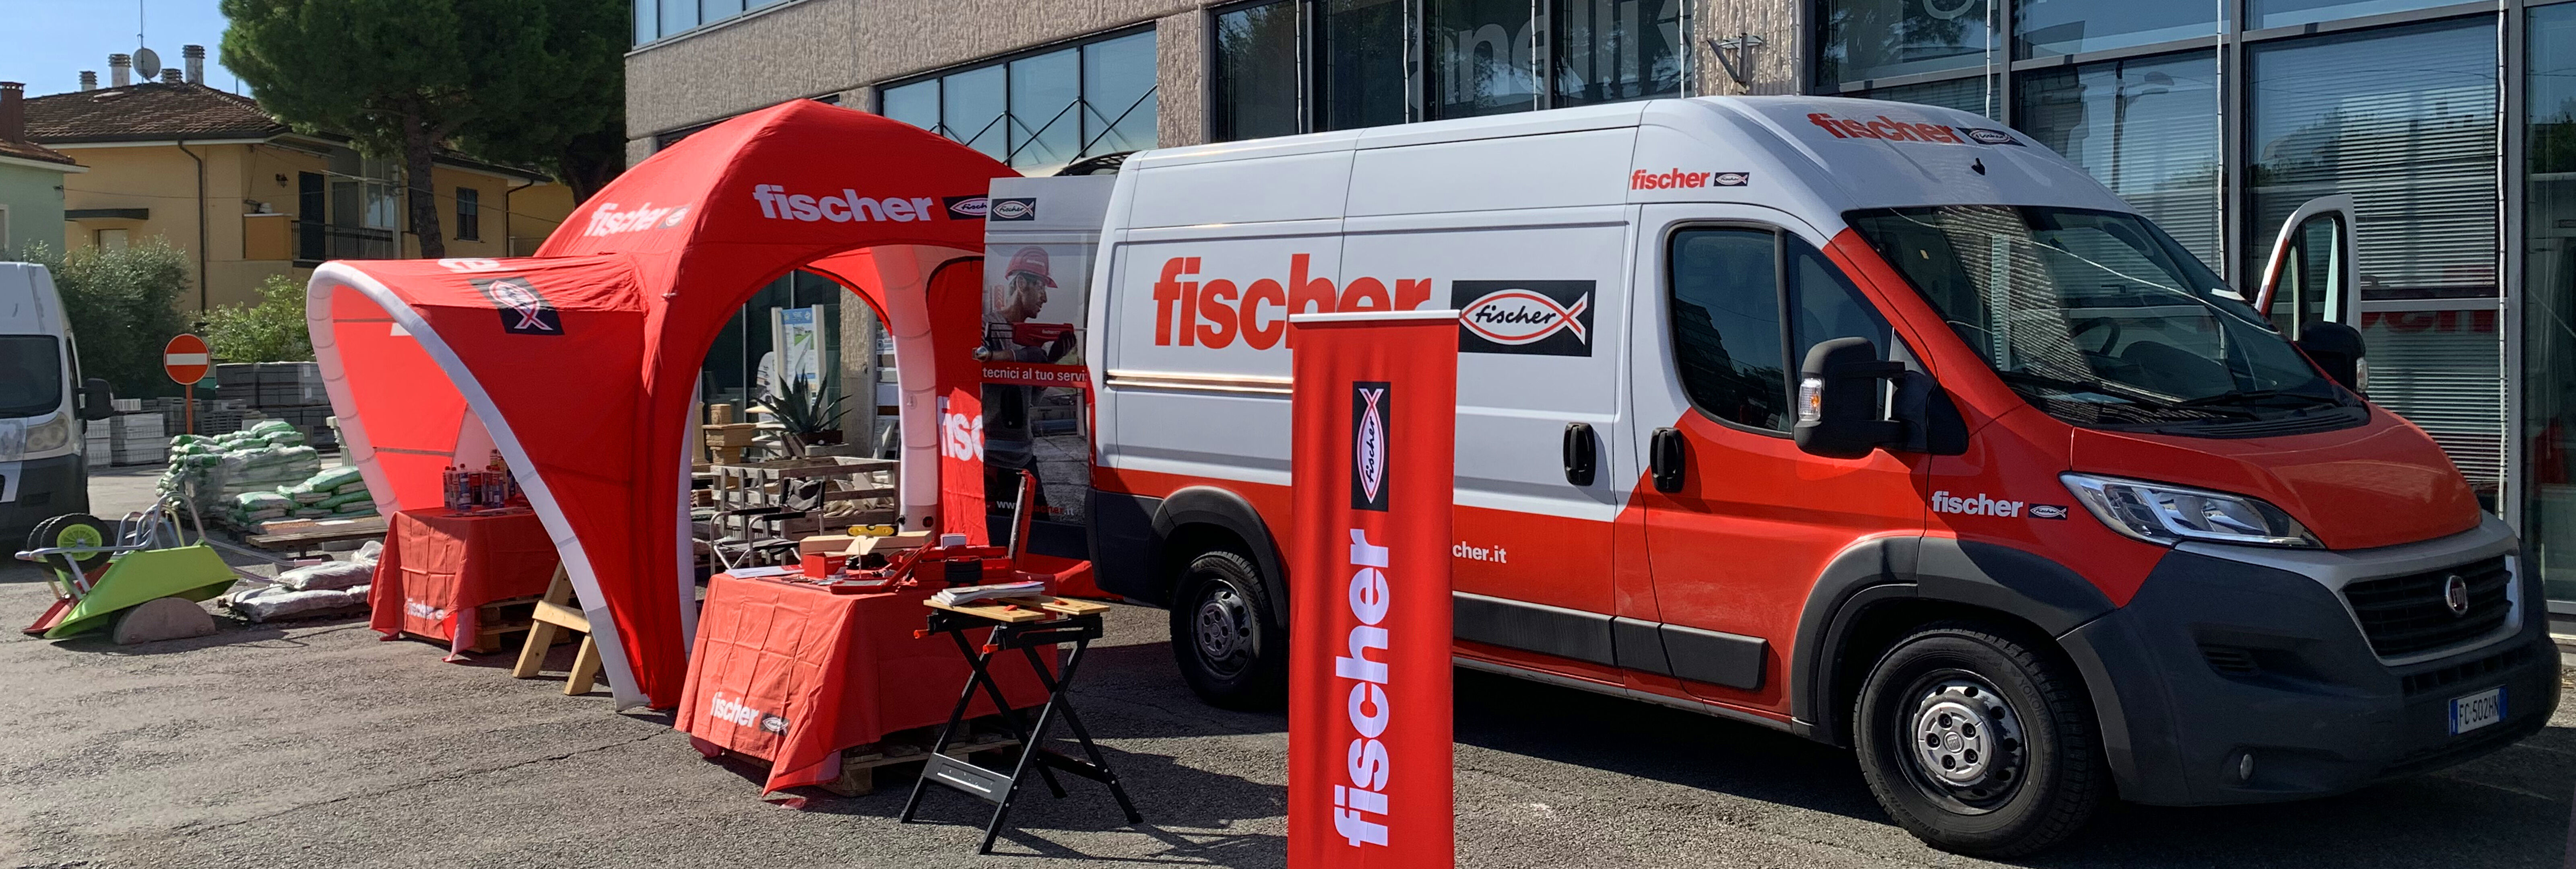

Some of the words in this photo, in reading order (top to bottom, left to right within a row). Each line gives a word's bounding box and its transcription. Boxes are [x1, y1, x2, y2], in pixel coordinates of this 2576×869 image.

[1807, 113, 1966, 143] fischer
[1632, 168, 1710, 190] fischer
[752, 184, 933, 222] fischer
[584, 202, 671, 237] fischer
[1475, 305, 1556, 324] fischer
[983, 367, 1019, 379] tecnici
[1022, 368, 1032, 379] al
[1035, 370, 1054, 381] tuo
[1366, 416, 1375, 483] fischer
[1932, 490, 2024, 517] fischer
[1334, 529, 1390, 847] fischer
[710, 692, 760, 728] fischer
